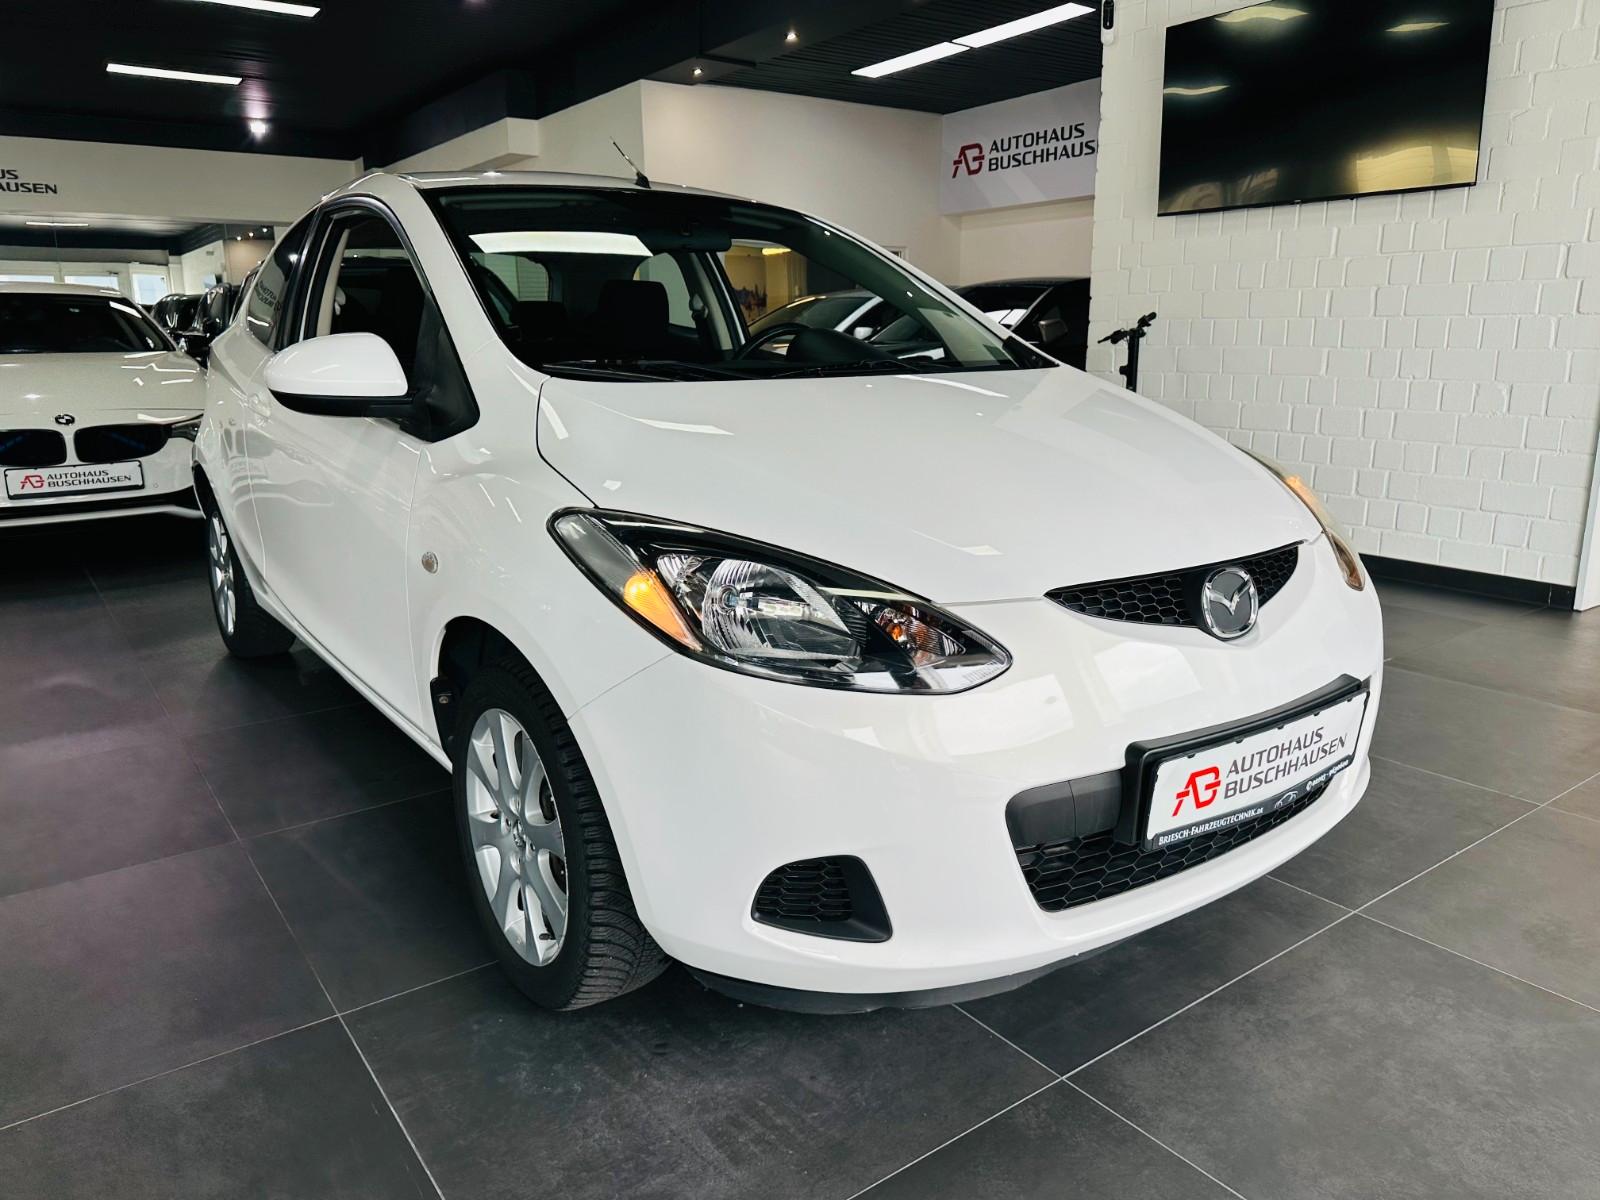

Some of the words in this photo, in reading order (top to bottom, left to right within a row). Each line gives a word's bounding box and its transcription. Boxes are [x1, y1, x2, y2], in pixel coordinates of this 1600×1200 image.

[989, 122, 1085, 154] AUTOHAUS
[988, 140, 1098, 171] BUSCHHAUS
[47, 469, 109, 481] AUTOHAUS
[48, 474, 132, 488] BUSCHHAUSEN
[1224, 733, 1348, 800] BUSCHHAUSEN
[1226, 726, 1325, 778] AUTOHAUS
